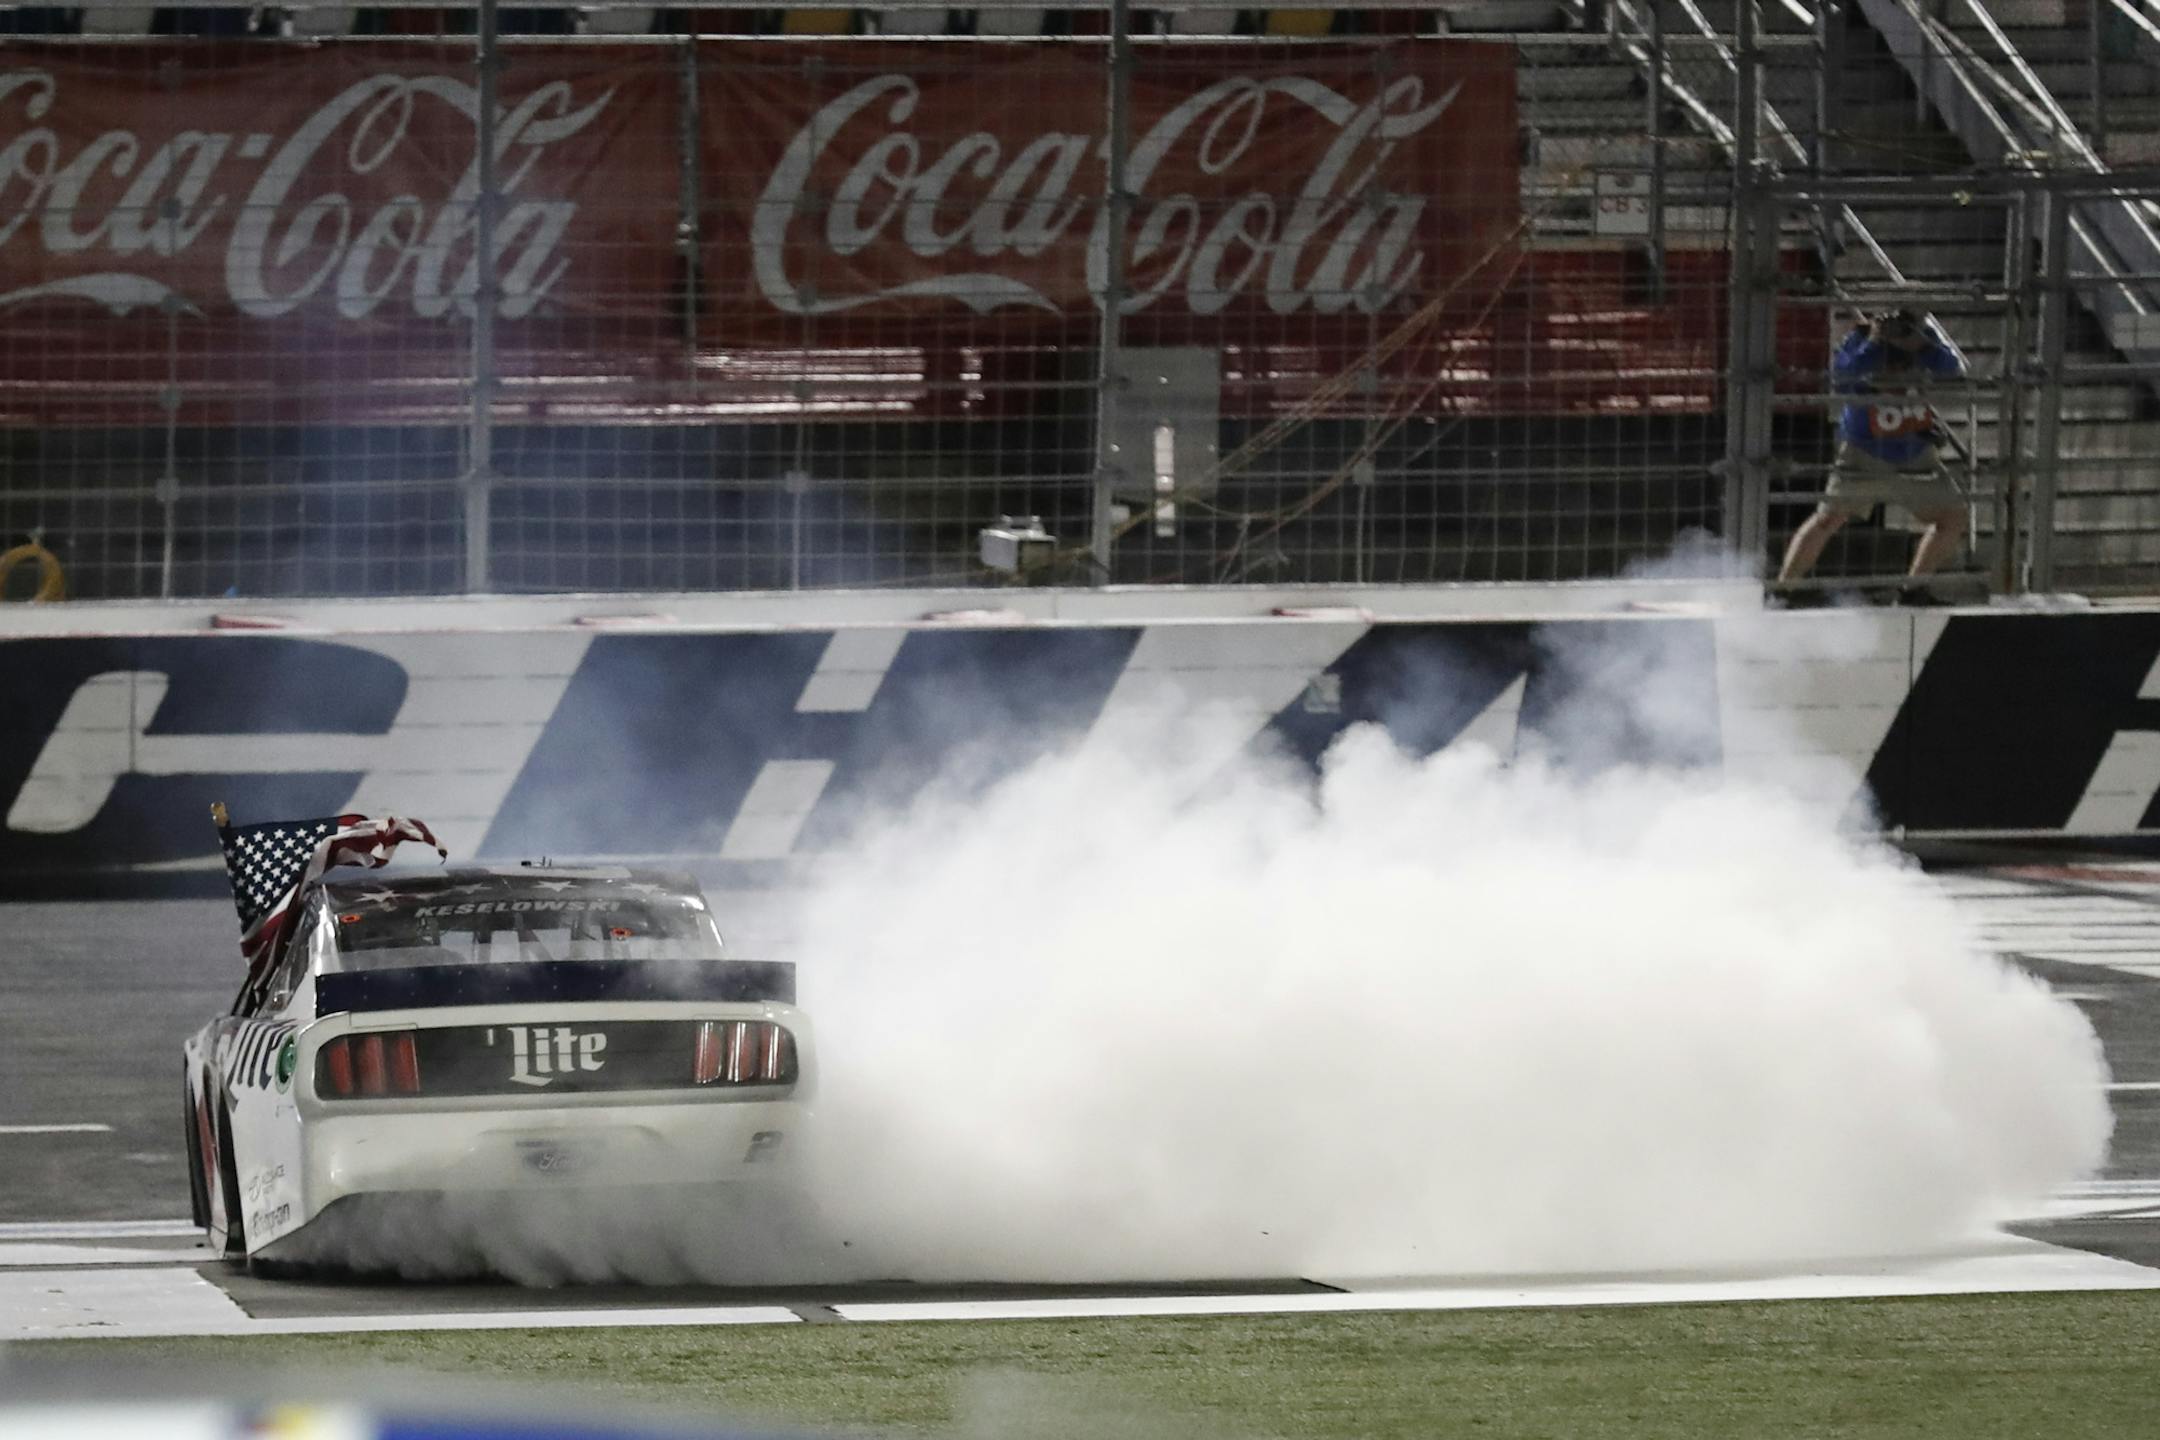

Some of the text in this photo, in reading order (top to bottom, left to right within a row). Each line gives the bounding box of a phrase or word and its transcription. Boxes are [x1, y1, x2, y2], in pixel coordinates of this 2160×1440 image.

[751, 74, 1463, 315] Coca-Cola
[415, 901, 620, 917] KESELOWSKI
[508, 1027, 607, 1086] Lite
